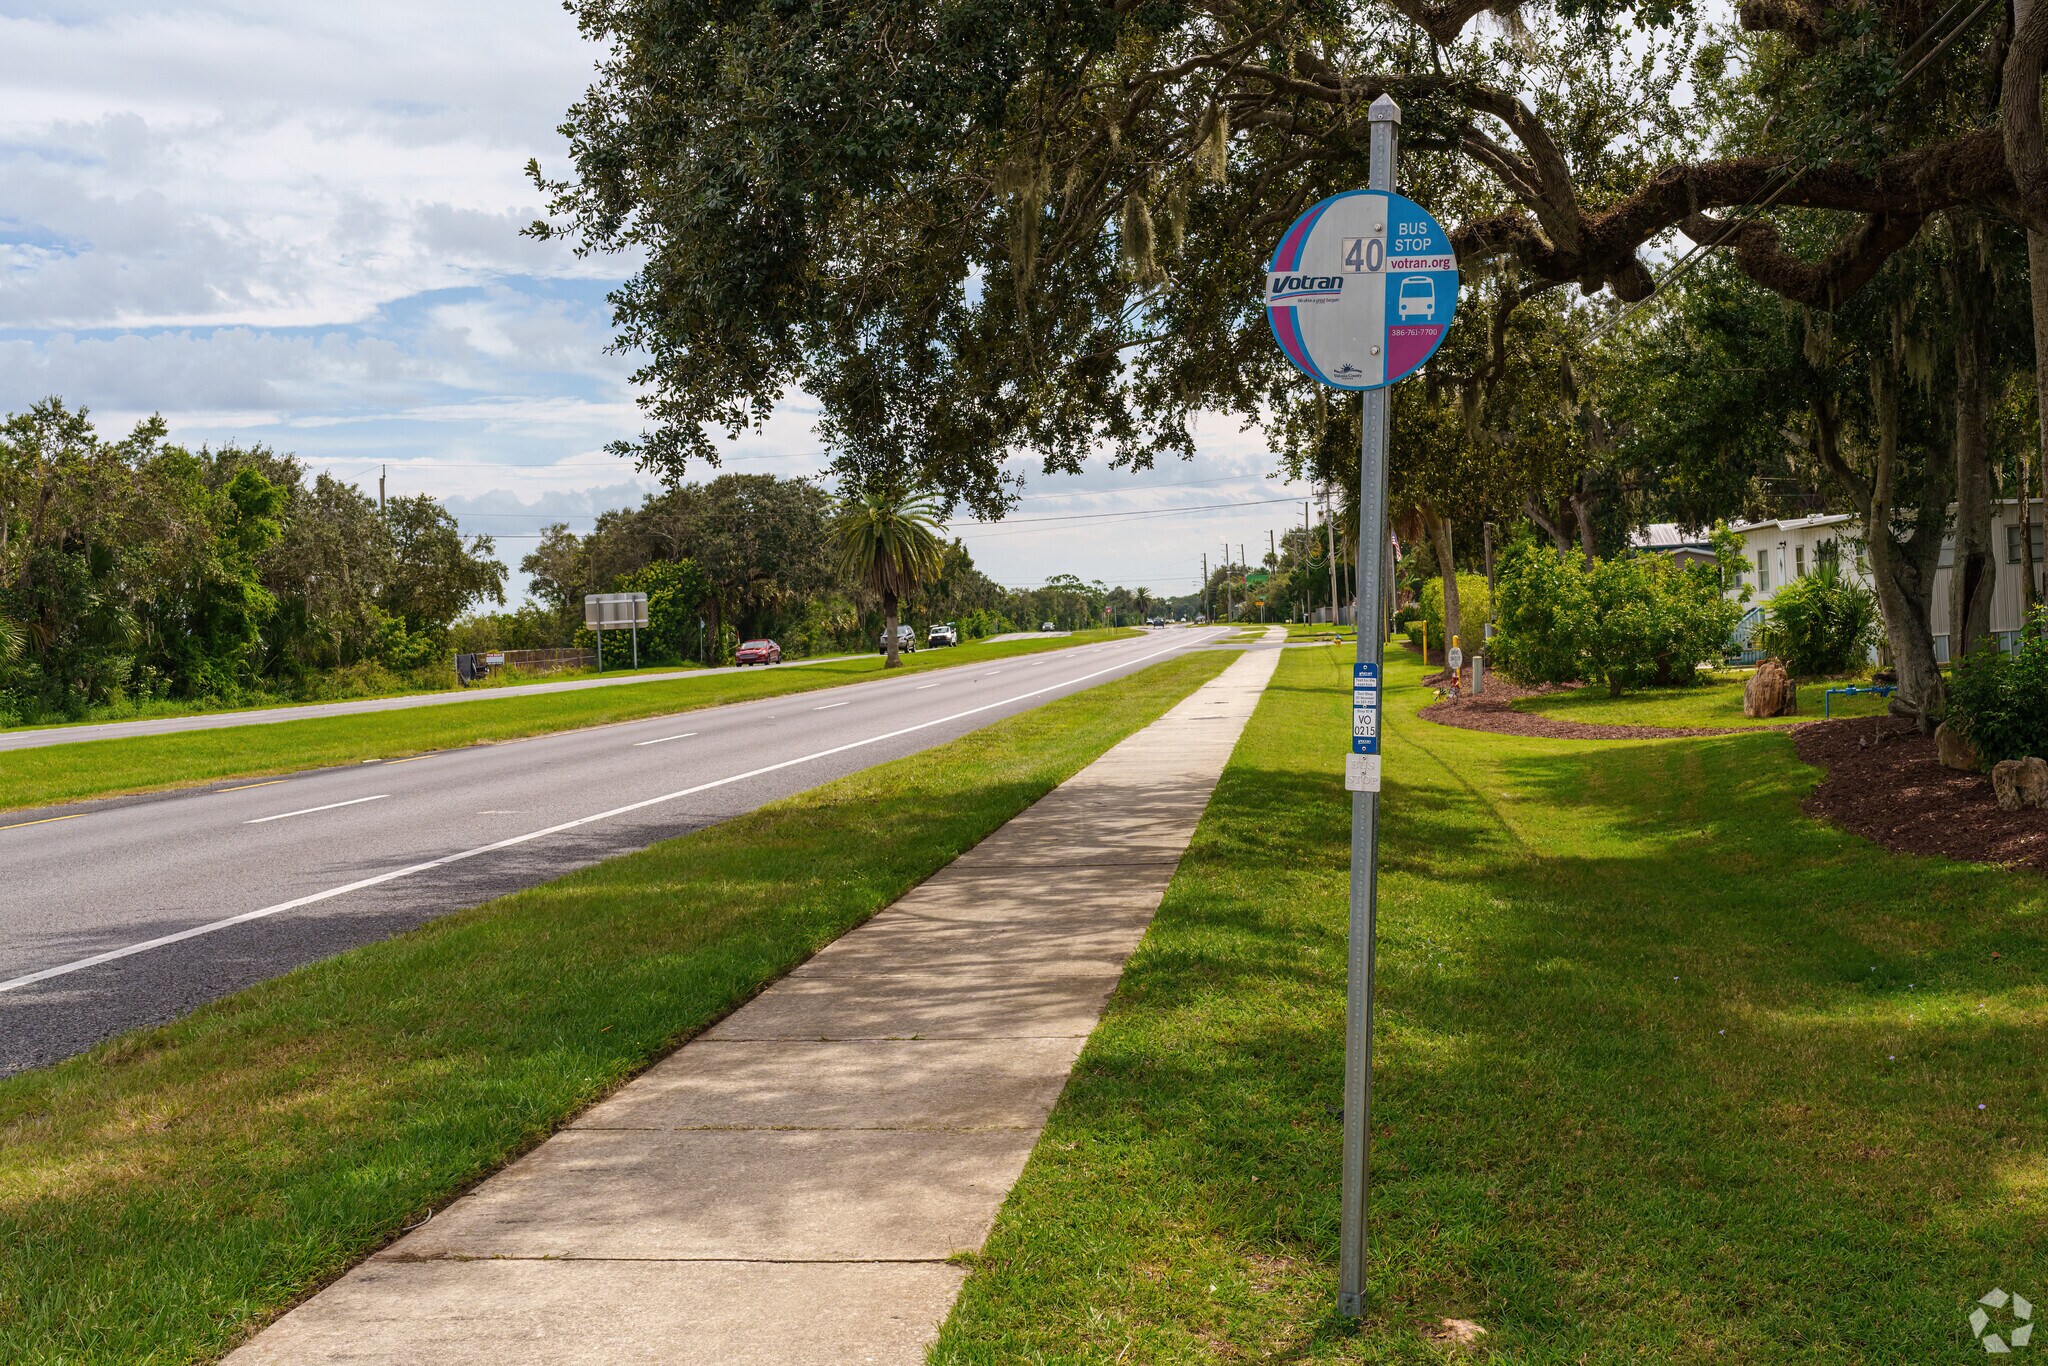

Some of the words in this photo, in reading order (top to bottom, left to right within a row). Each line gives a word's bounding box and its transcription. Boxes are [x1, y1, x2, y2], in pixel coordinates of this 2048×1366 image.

[1398, 222, 1428, 236] BUS
[1394, 238, 1432, 252] STOP
[1345, 238, 1383, 272] 40
[1391, 257, 1450, 271] votran.org
[1272, 275, 1344, 294] Votran
[1391, 328, 1438, 337] 386-761-7700
[1358, 715, 1372, 725] VO
[1354, 726, 1375, 735] 0215
